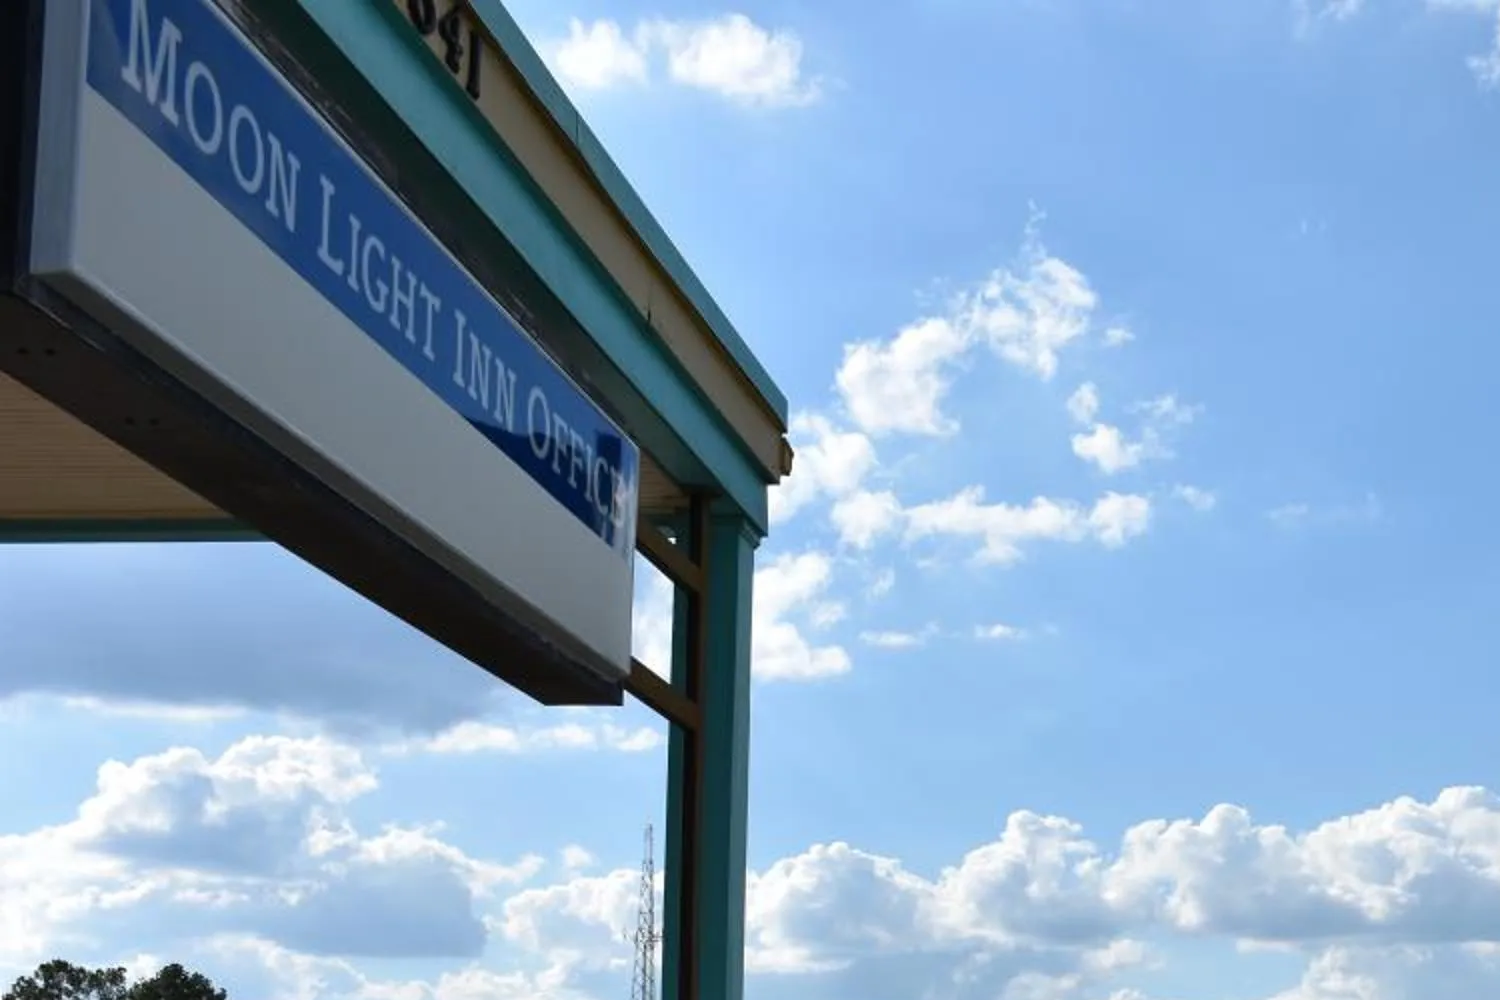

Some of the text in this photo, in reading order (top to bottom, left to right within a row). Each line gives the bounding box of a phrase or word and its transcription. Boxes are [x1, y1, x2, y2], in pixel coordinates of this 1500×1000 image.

[121, 0, 301, 233] MOON
[317, 174, 441, 362] LIGHT
[453, 309, 517, 433] INN
